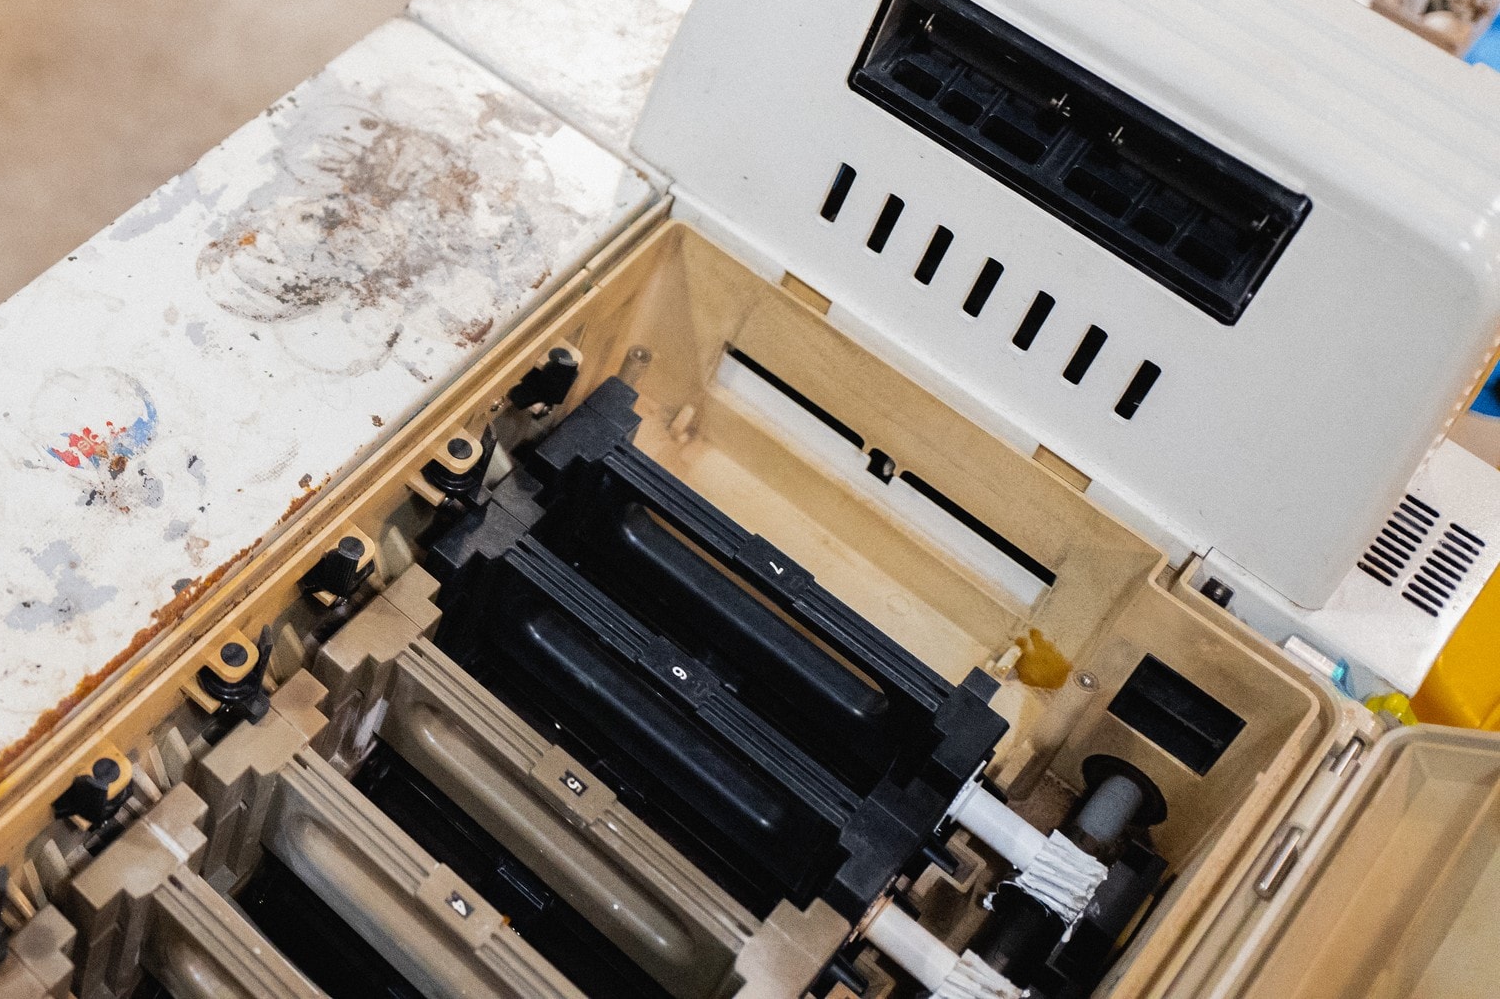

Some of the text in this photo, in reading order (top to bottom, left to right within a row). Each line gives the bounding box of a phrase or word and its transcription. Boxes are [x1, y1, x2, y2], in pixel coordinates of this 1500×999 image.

[768, 561, 784, 575] 7
[566, 777, 583, 793] 5
[451, 899, 467, 916] 4
